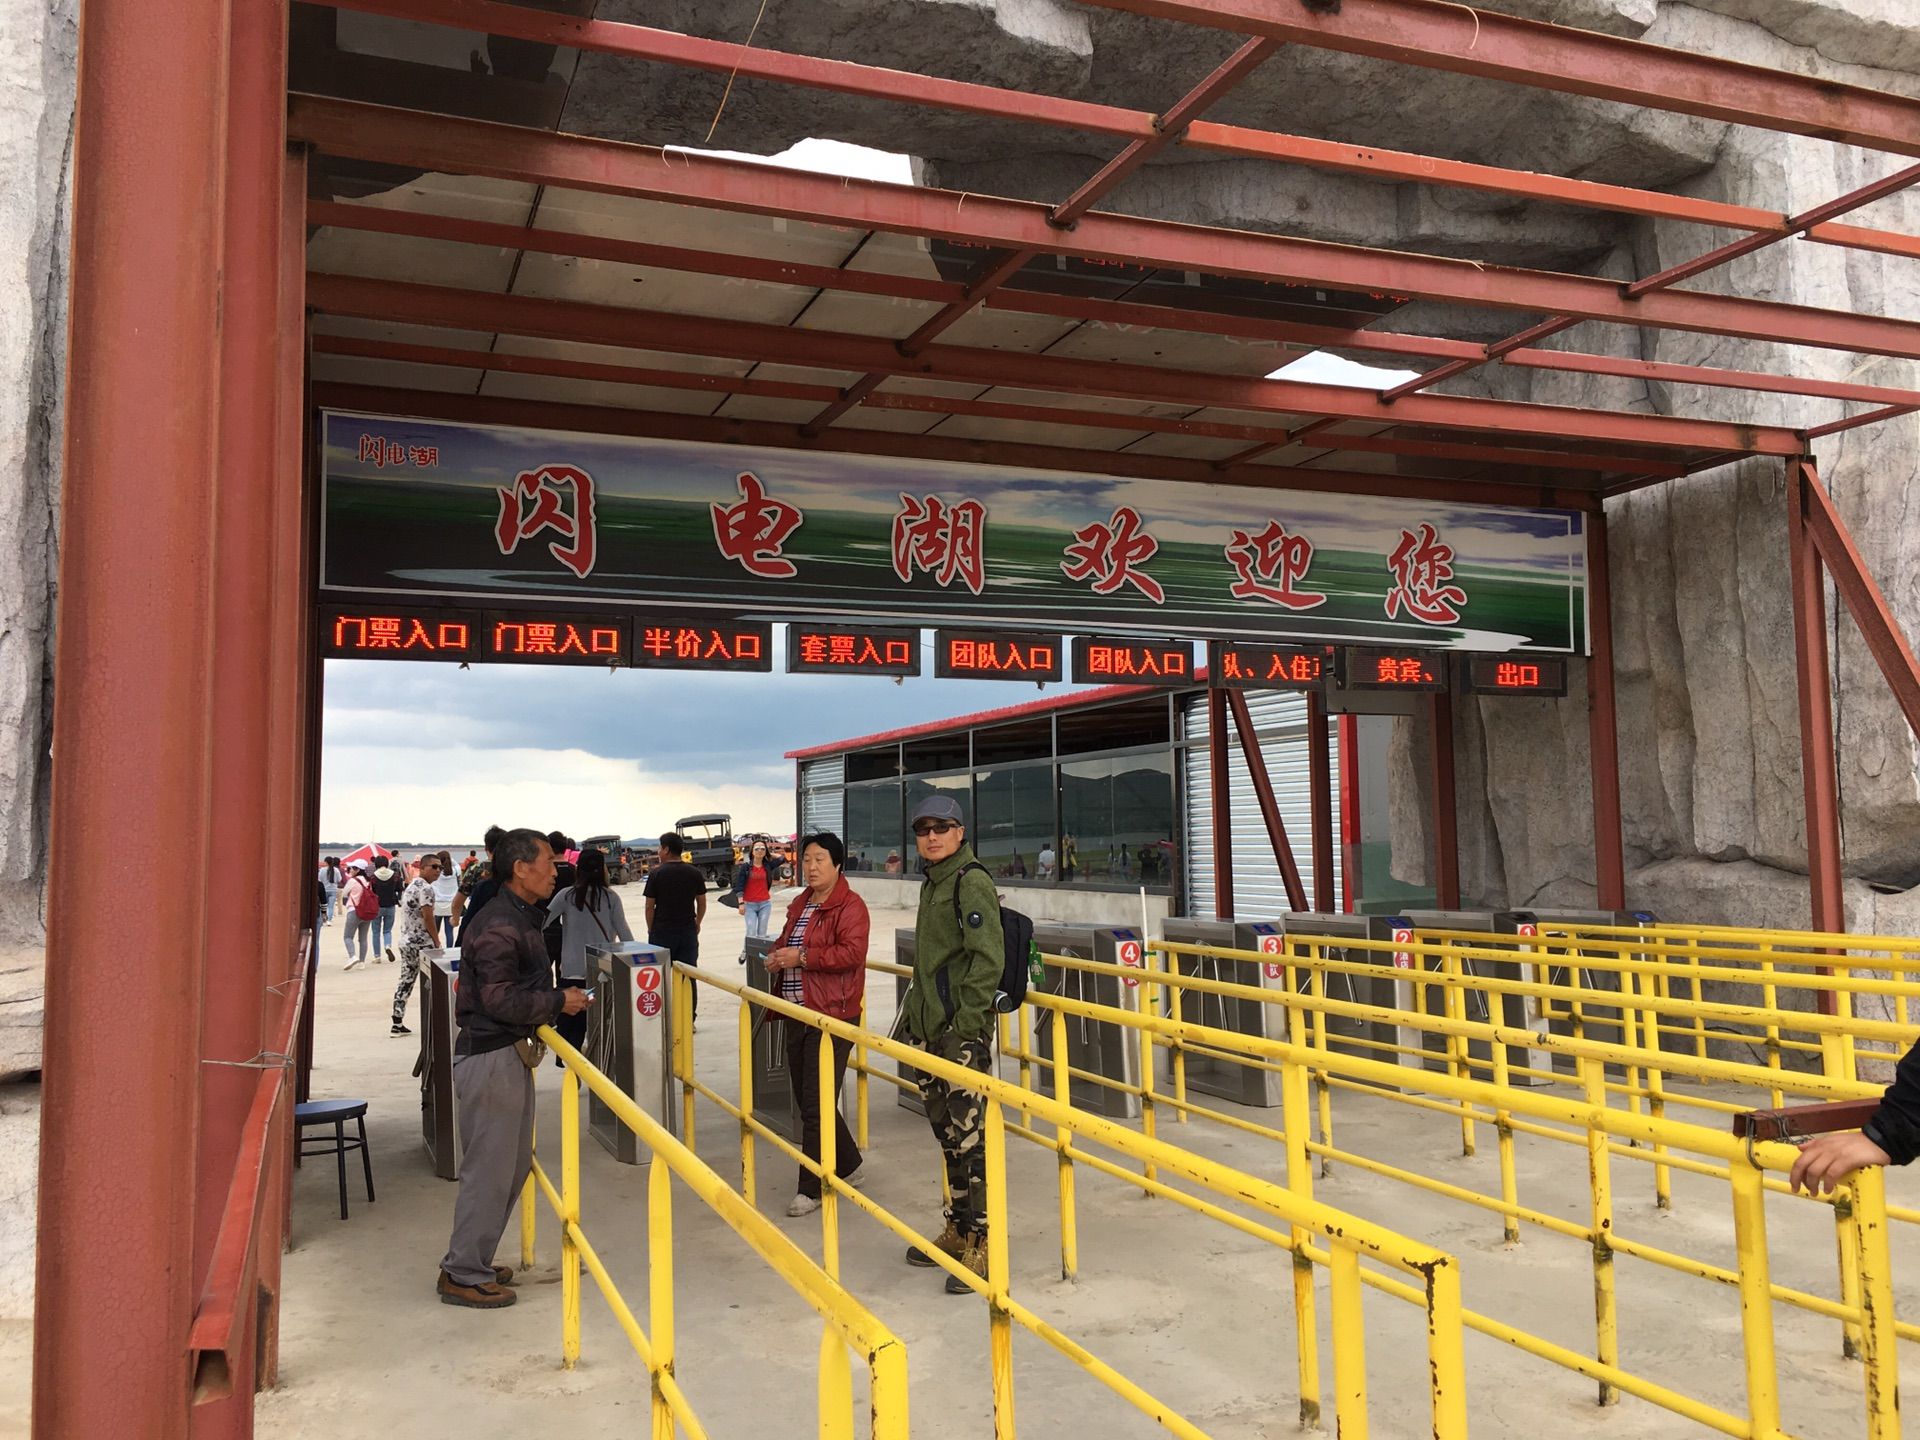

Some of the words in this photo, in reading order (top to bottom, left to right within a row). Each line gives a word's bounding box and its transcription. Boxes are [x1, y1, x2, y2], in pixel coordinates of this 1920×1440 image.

[357, 434, 439, 468] 闪电湖
[495, 463, 1468, 625] 闪电湖欢迎您
[335, 616, 467, 650] 门票入口
[495, 622, 618, 654] 门票入口
[643, 628, 760, 659] 半价入口
[801, 634, 909, 665] 套票入口
[951, 640, 1052, 670] 团队入口
[1089, 646, 1184, 675] 团队入口
[1497, 662, 1538, 687] 出口
[1268, 939, 1278, 954] 3
[1400, 930, 1410, 943] 2
[1125, 945, 1136, 960] 4
[643, 970, 655, 988] 7
[642, 992, 657, 1002] 30
[643, 1002, 656, 1014] 元
